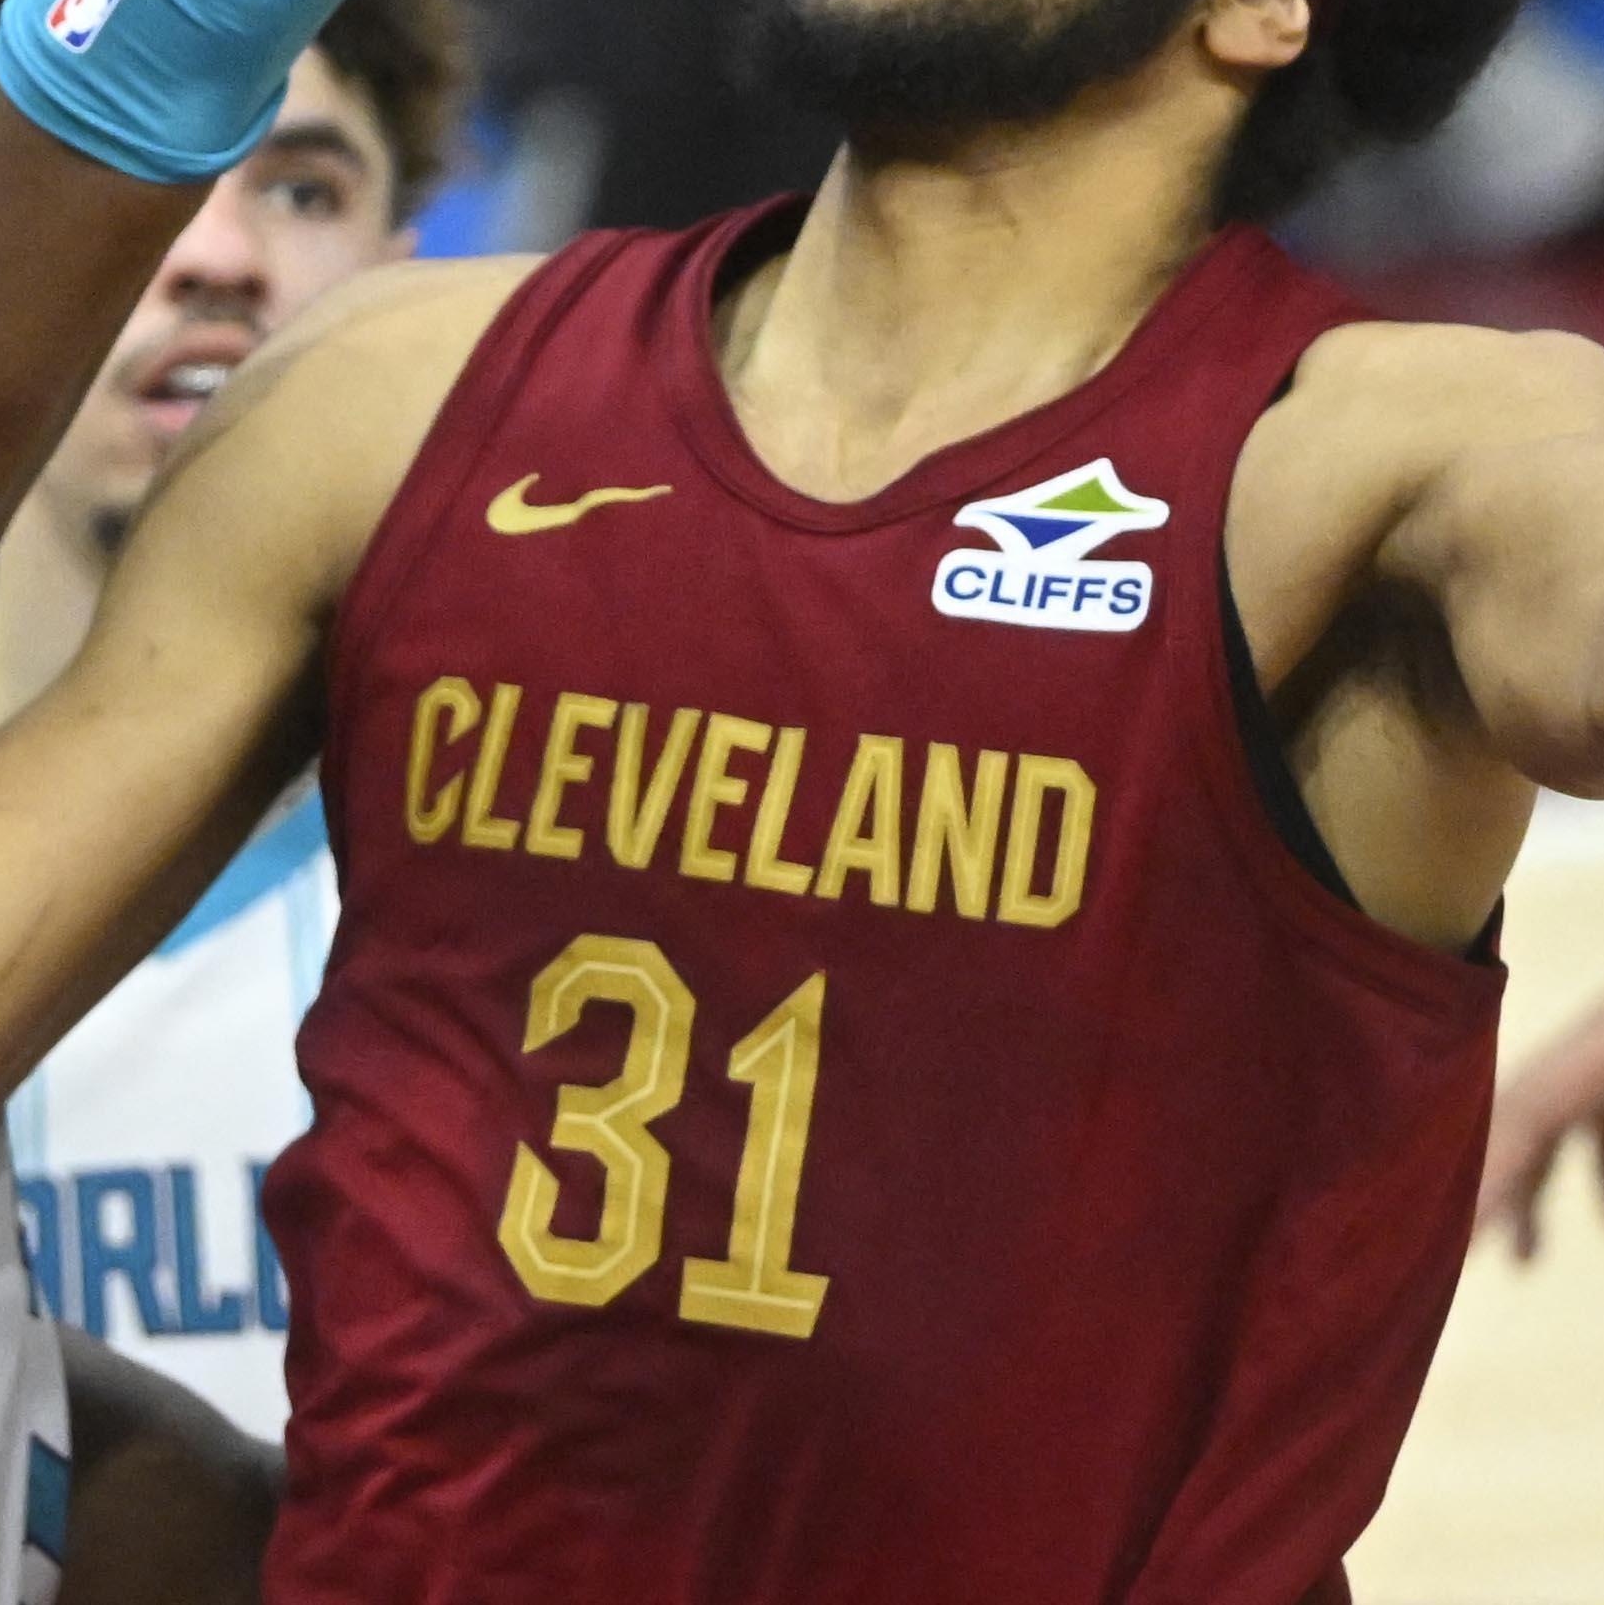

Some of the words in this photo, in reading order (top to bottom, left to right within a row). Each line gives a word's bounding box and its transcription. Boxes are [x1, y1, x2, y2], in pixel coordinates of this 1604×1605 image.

[944, 565, 1143, 615] CLIFFS
[404, 676, 1097, 929] CLEVELAND
[497, 932, 830, 1340] 31
